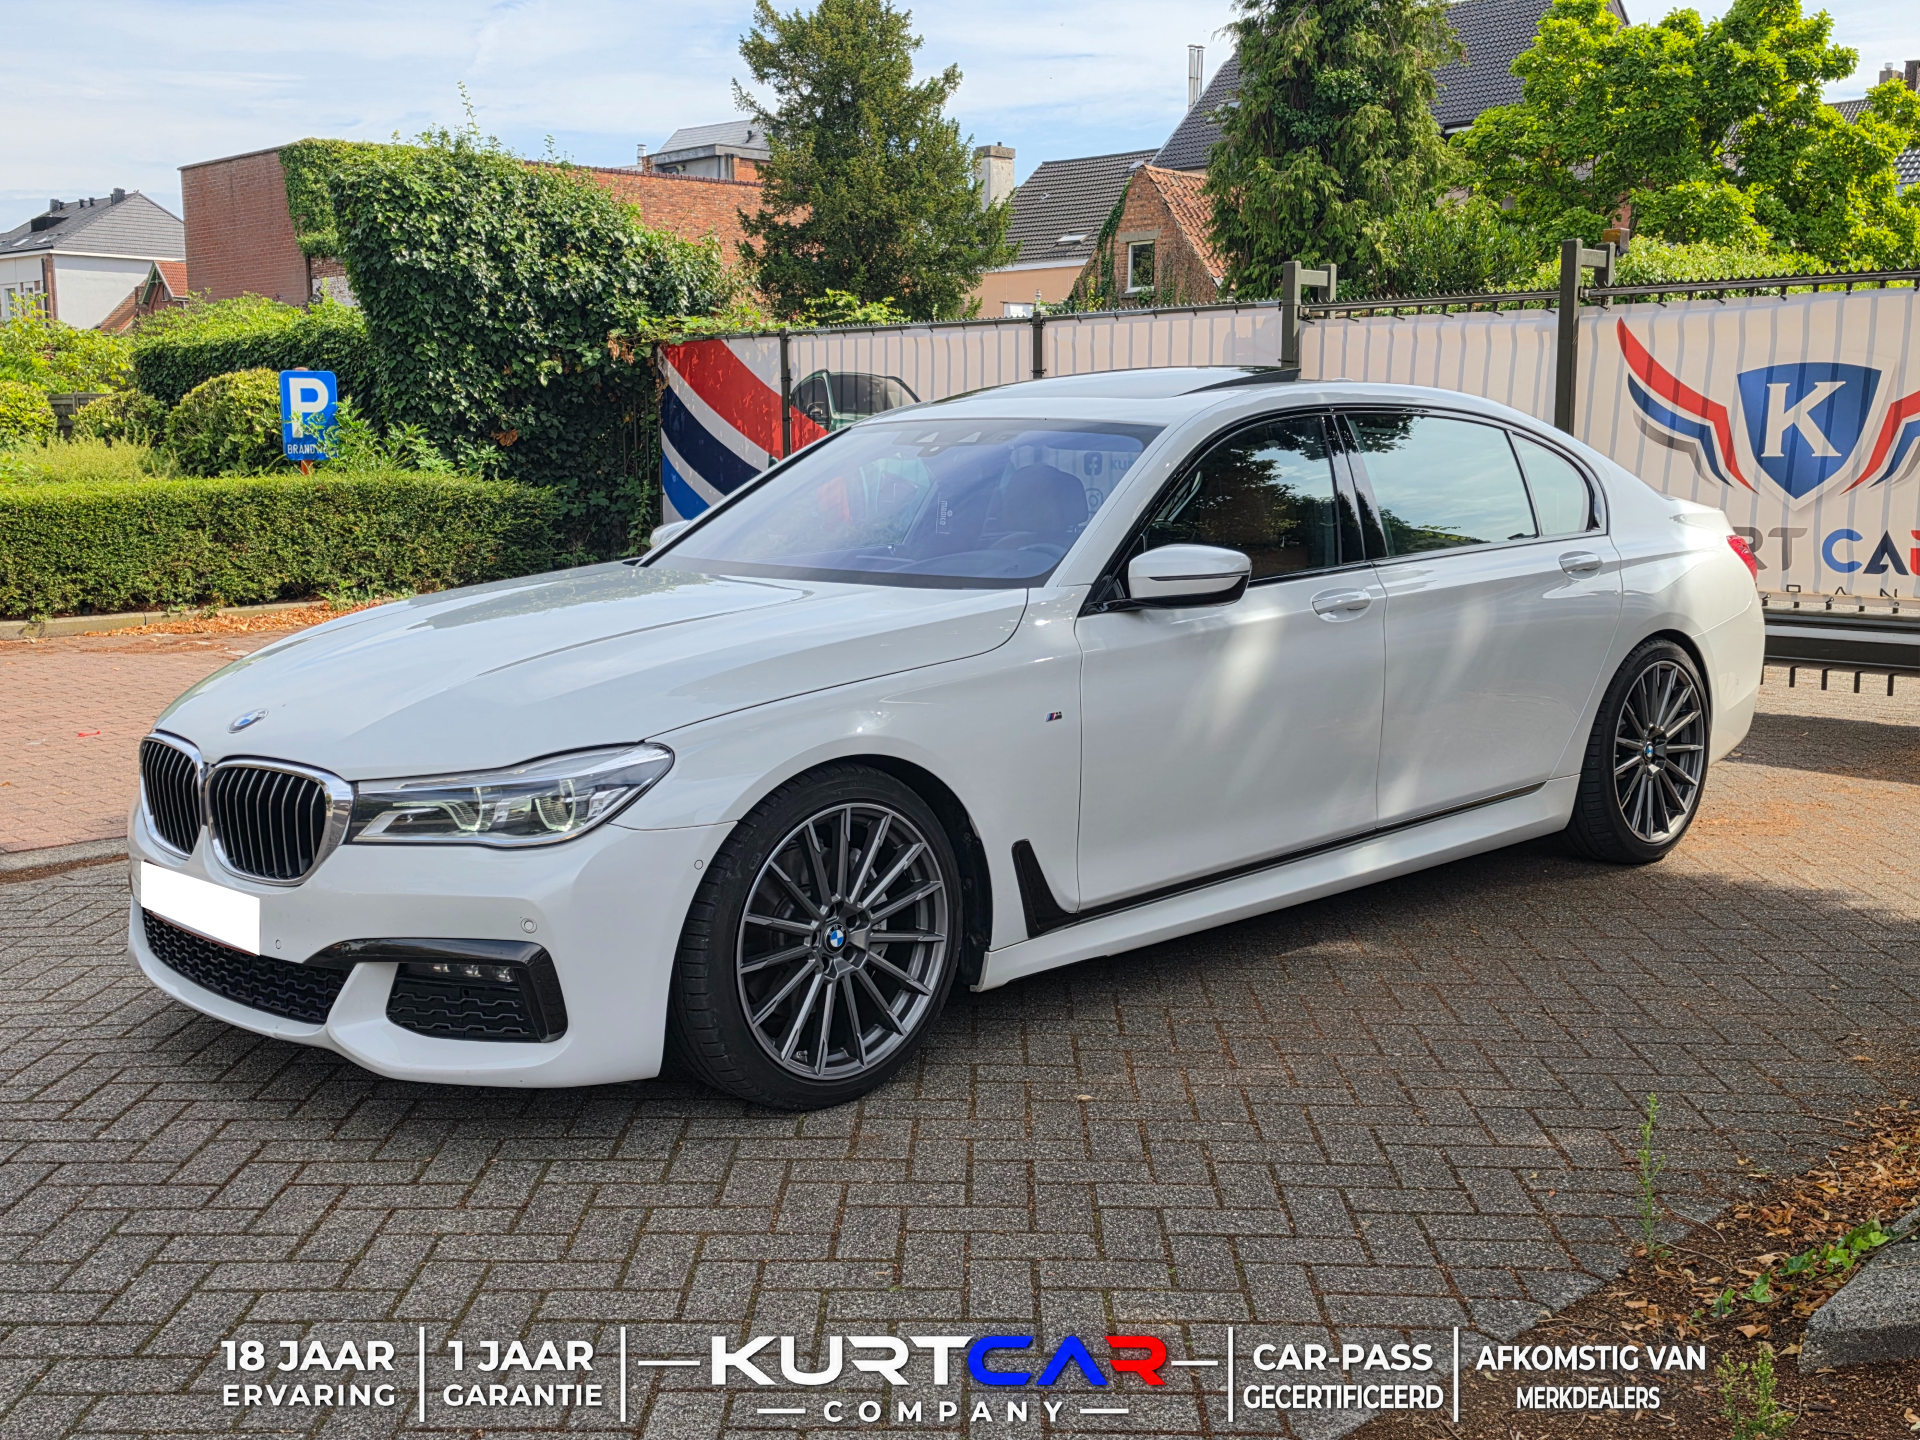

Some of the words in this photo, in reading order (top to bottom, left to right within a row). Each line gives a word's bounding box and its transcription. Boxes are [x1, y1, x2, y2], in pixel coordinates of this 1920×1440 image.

[289, 378, 329, 438] P
[1761, 381, 1846, 457] K
[287, 444, 329, 455] BRAND
[1822, 528, 1920, 576] CA
